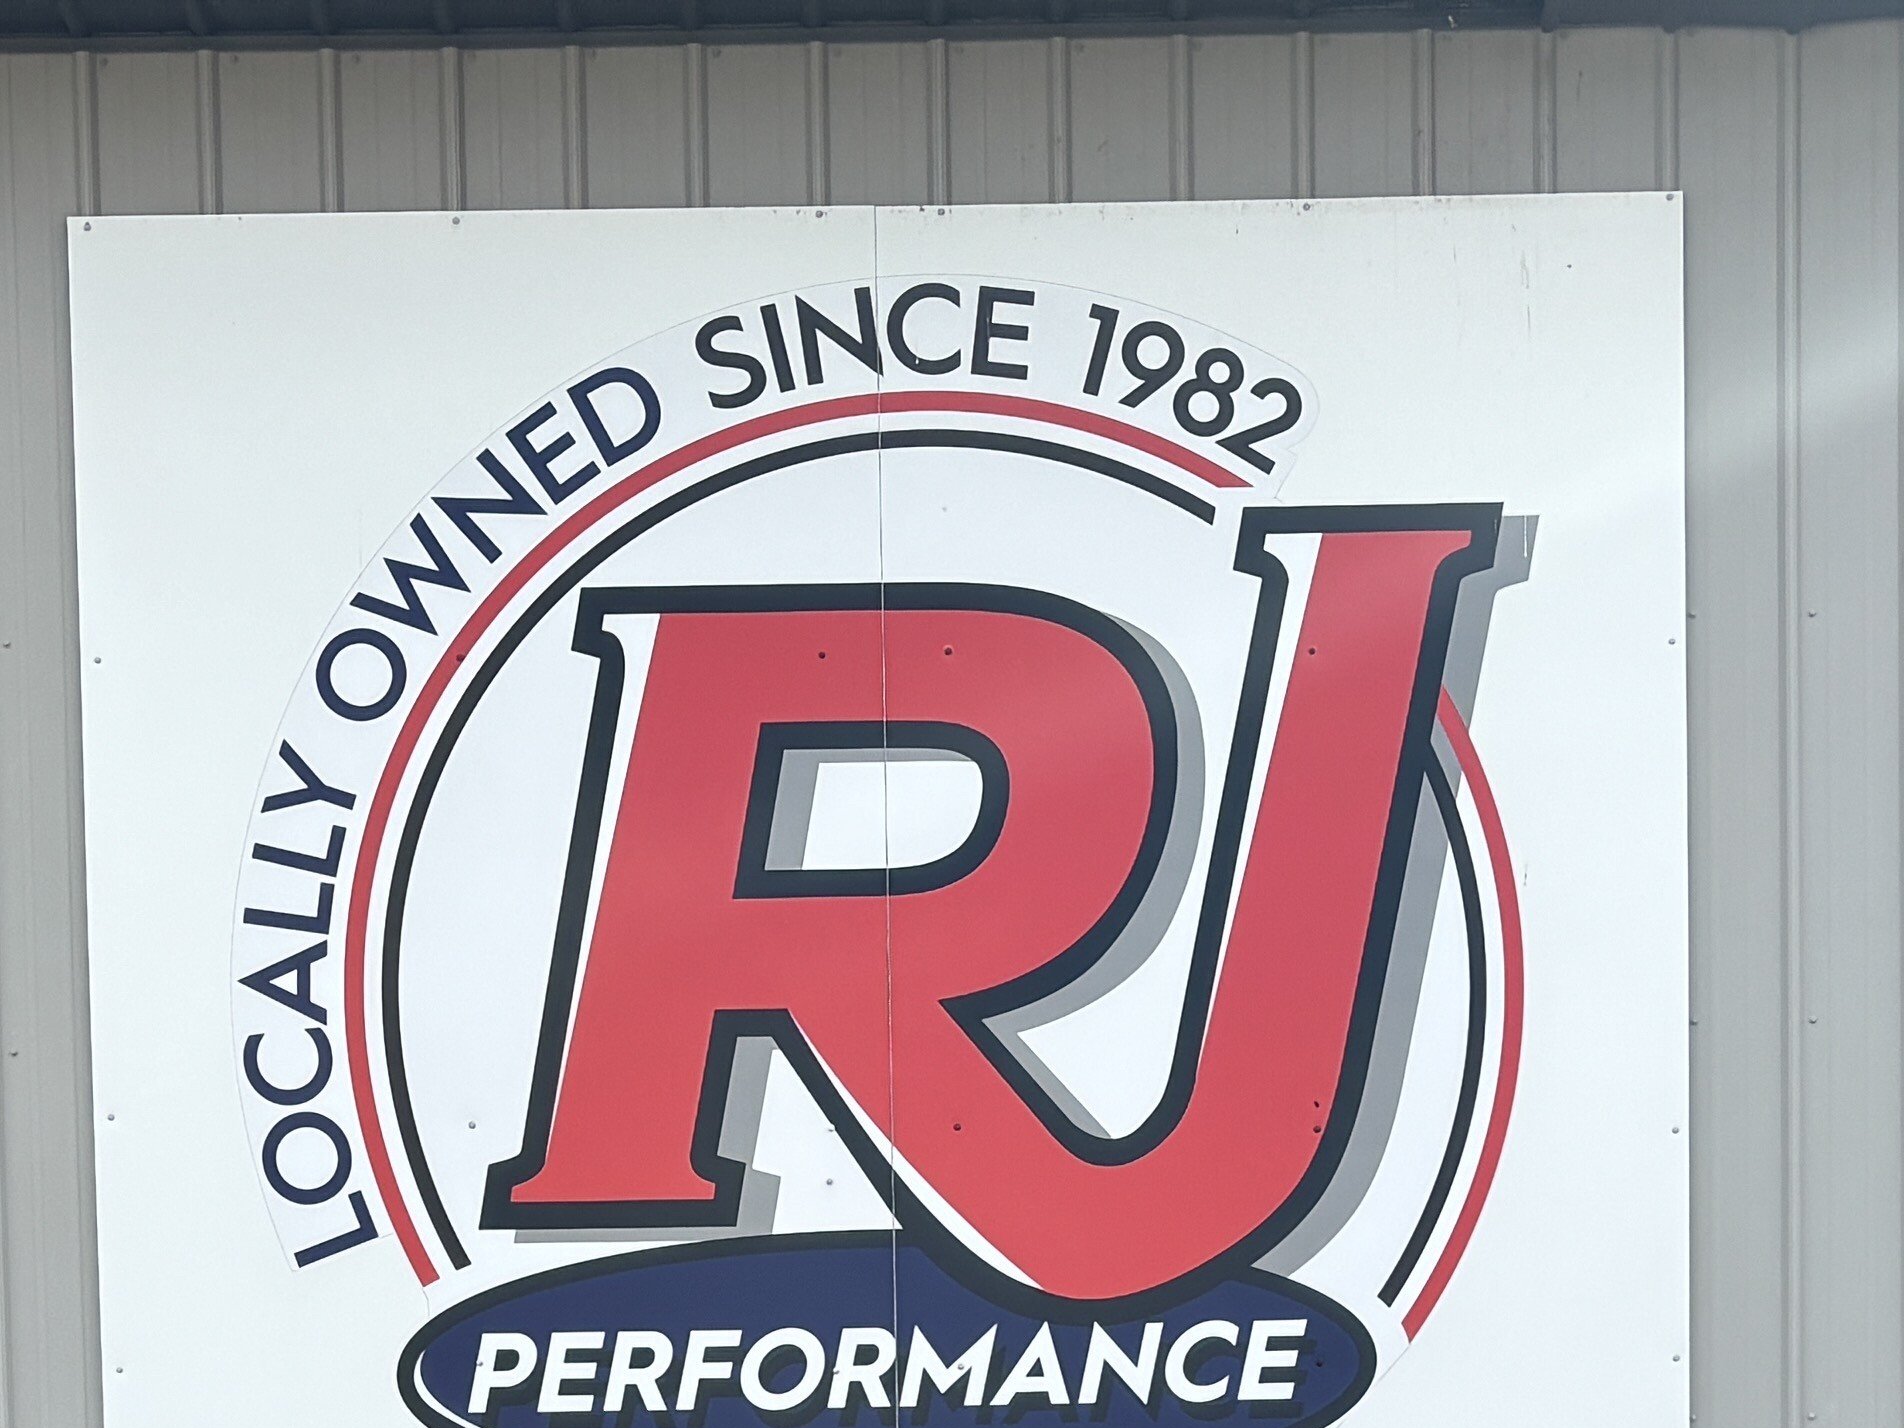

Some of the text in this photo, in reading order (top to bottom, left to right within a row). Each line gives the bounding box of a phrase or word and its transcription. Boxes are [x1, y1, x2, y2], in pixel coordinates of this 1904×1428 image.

[238, 283, 1301, 1268] LOCALLY OWNED SINCE 1982
[482, 503, 1504, 1316] RJ
[467, 1319, 1308, 1414] PERFORMANCE
